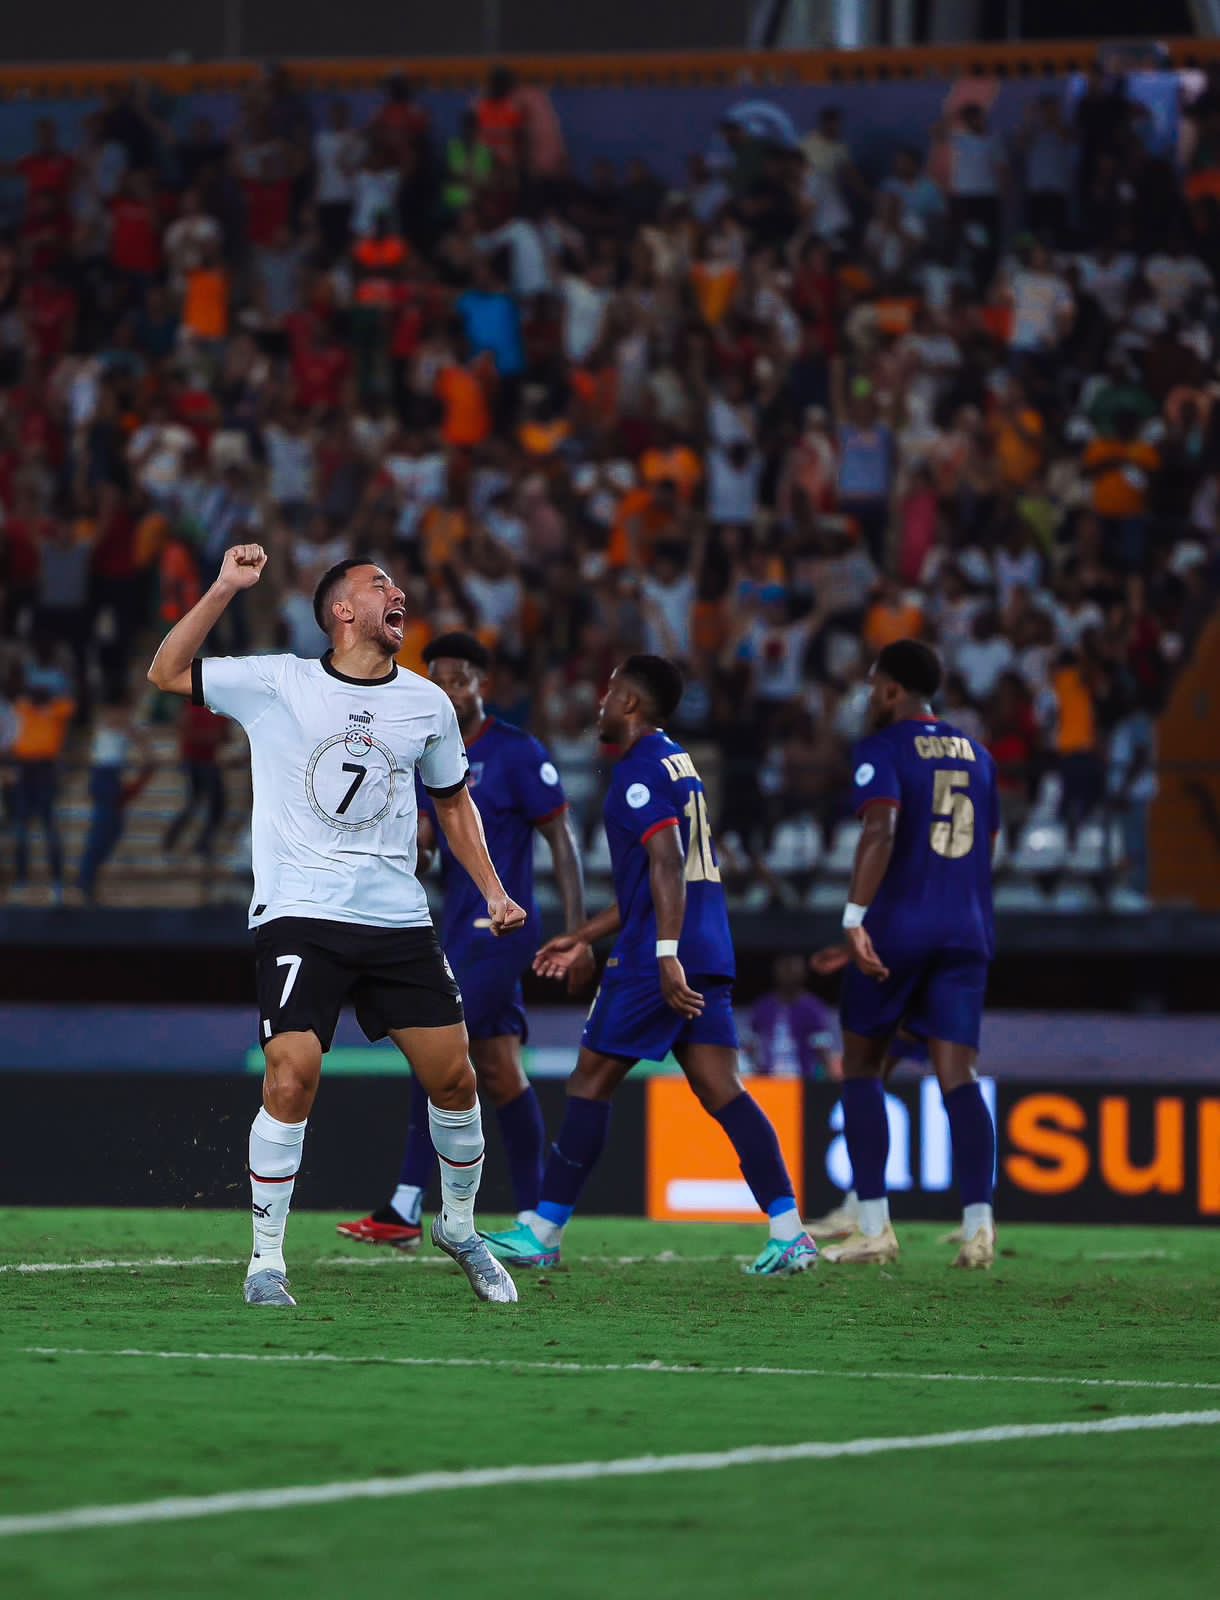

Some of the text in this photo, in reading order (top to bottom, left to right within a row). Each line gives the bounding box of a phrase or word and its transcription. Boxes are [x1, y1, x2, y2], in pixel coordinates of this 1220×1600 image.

[349, 713, 371, 725] PUMA
[914, 735, 976, 762] COSTA
[336, 762, 367, 814] 7
[930, 769, 975, 859] 5
[276, 954, 303, 1008] 7
